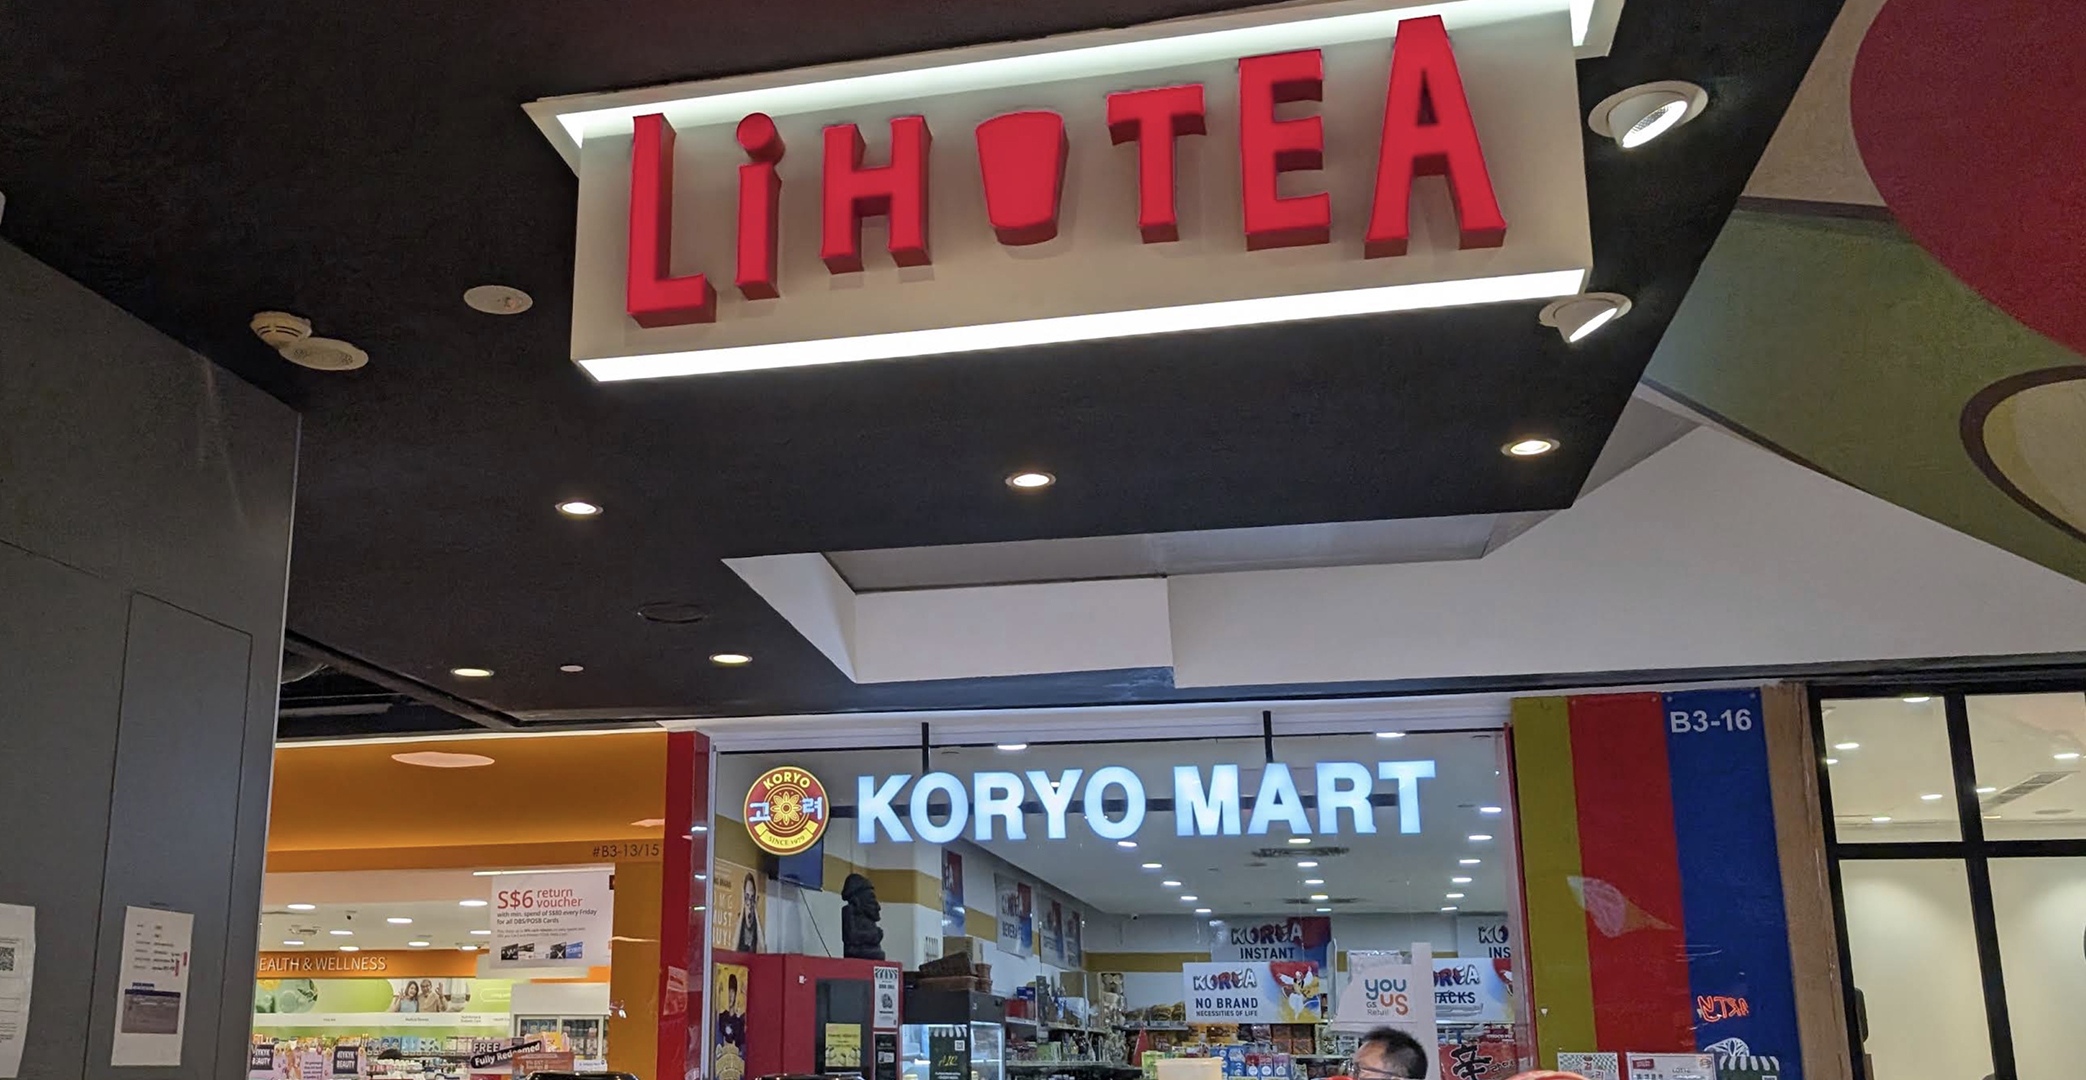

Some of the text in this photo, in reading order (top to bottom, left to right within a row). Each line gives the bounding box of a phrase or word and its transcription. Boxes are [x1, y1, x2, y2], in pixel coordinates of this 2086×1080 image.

[1104, 14, 1507, 259] TEA
[1669, 708, 1753, 733] B3-16
[763, 771, 811, 790] KORYO
[857, 759, 1435, 843] KORYO MART
[767, 835, 788, 846] SINCE
[593, 843, 660, 858] #B3-13/15
[497, 889, 534, 910] S$6
[537, 888, 573, 898] return
[536, 896, 584, 908] voucher
[1231, 921, 1303, 946] KOREA
[1240, 947, 1296, 960] INSTANT
[302, 956, 312, 971] &
[315, 956, 387, 971] WELLNESS
[1193, 967, 1258, 992] KOREA
[1364, 978, 1407, 1001] you
[1195, 997, 1259, 1009] NO BRAND
[1366, 1001, 1377, 1009] GS
[1195, 1010, 1234, 1018] NECESSITIES
[1244, 1009, 1258, 1017] LIFE
[472, 1041, 501, 1053] FREE
[336, 1060, 355, 1068] BEAUTY
[474, 1054, 496, 1067] Fully
